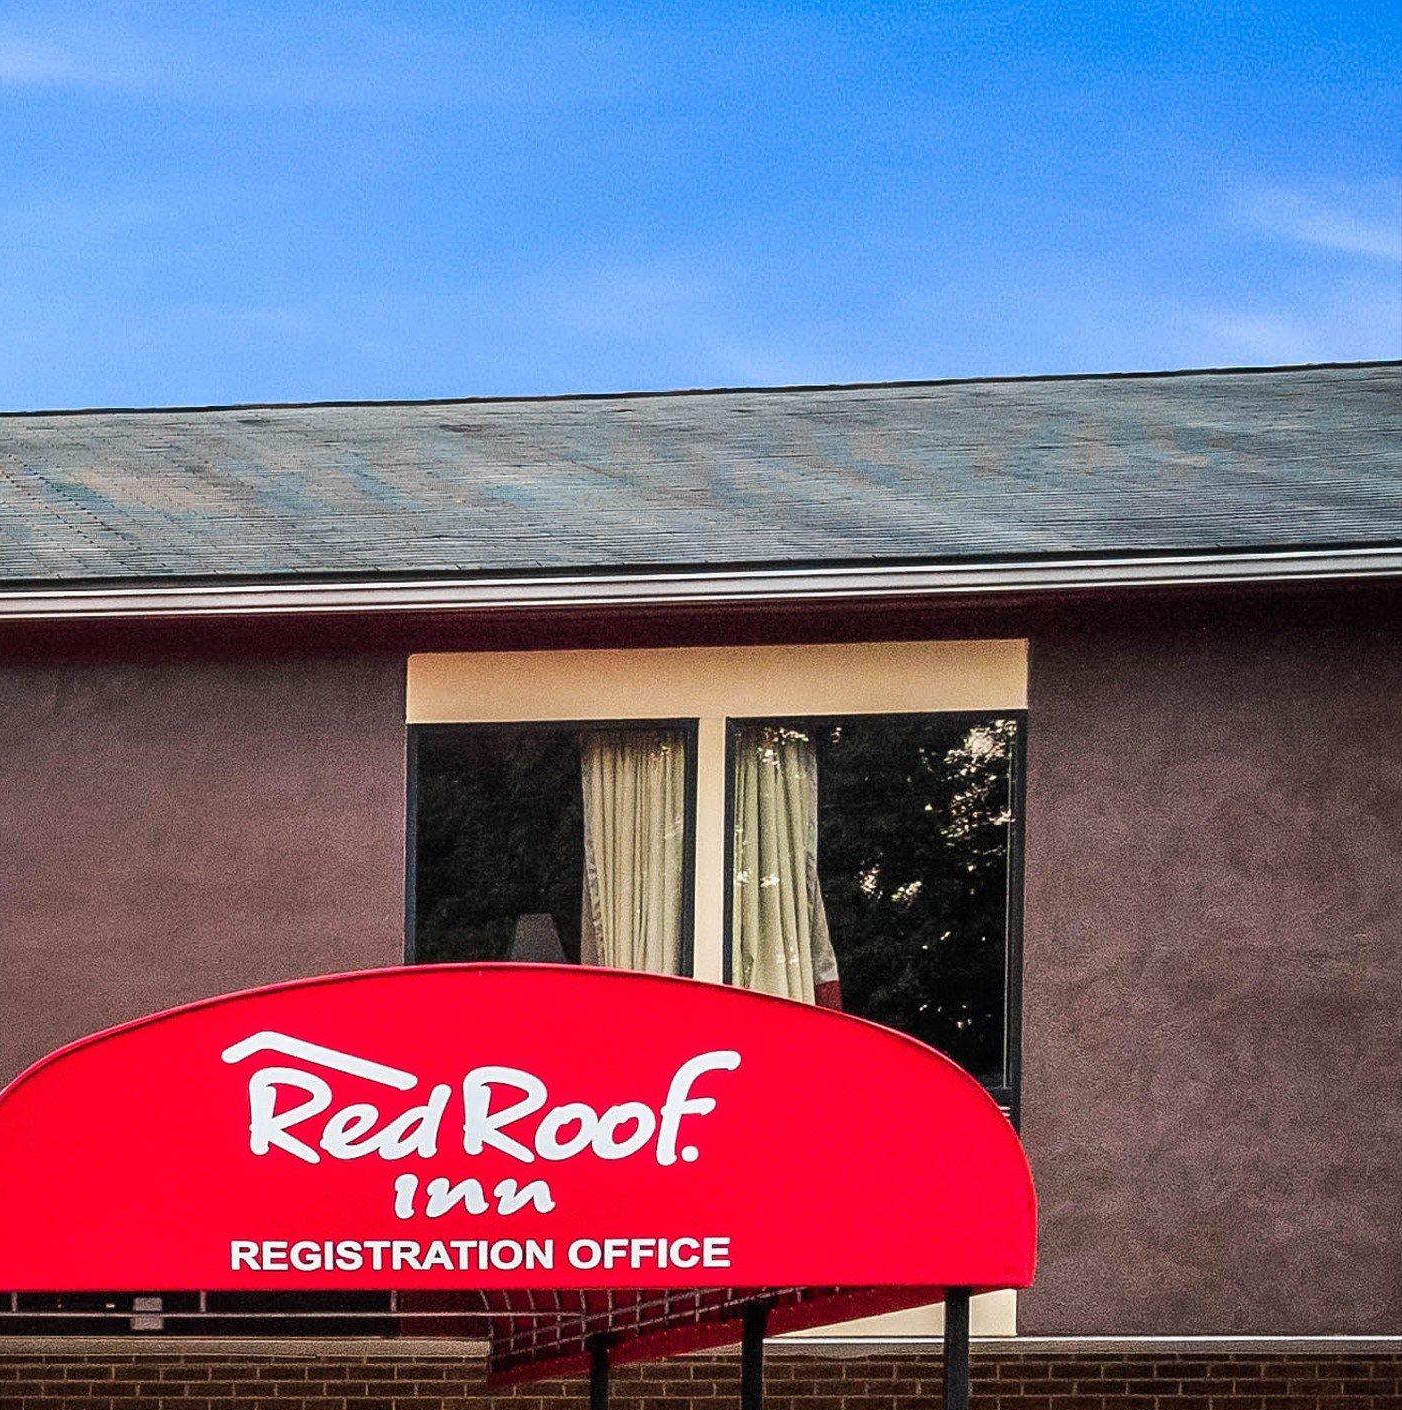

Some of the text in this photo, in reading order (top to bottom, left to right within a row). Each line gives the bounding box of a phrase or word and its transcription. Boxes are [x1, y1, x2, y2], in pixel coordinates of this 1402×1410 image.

[248, 1066, 452, 1164] Red
[230, 1237, 732, 1271] REGISTRATION OFFICE
